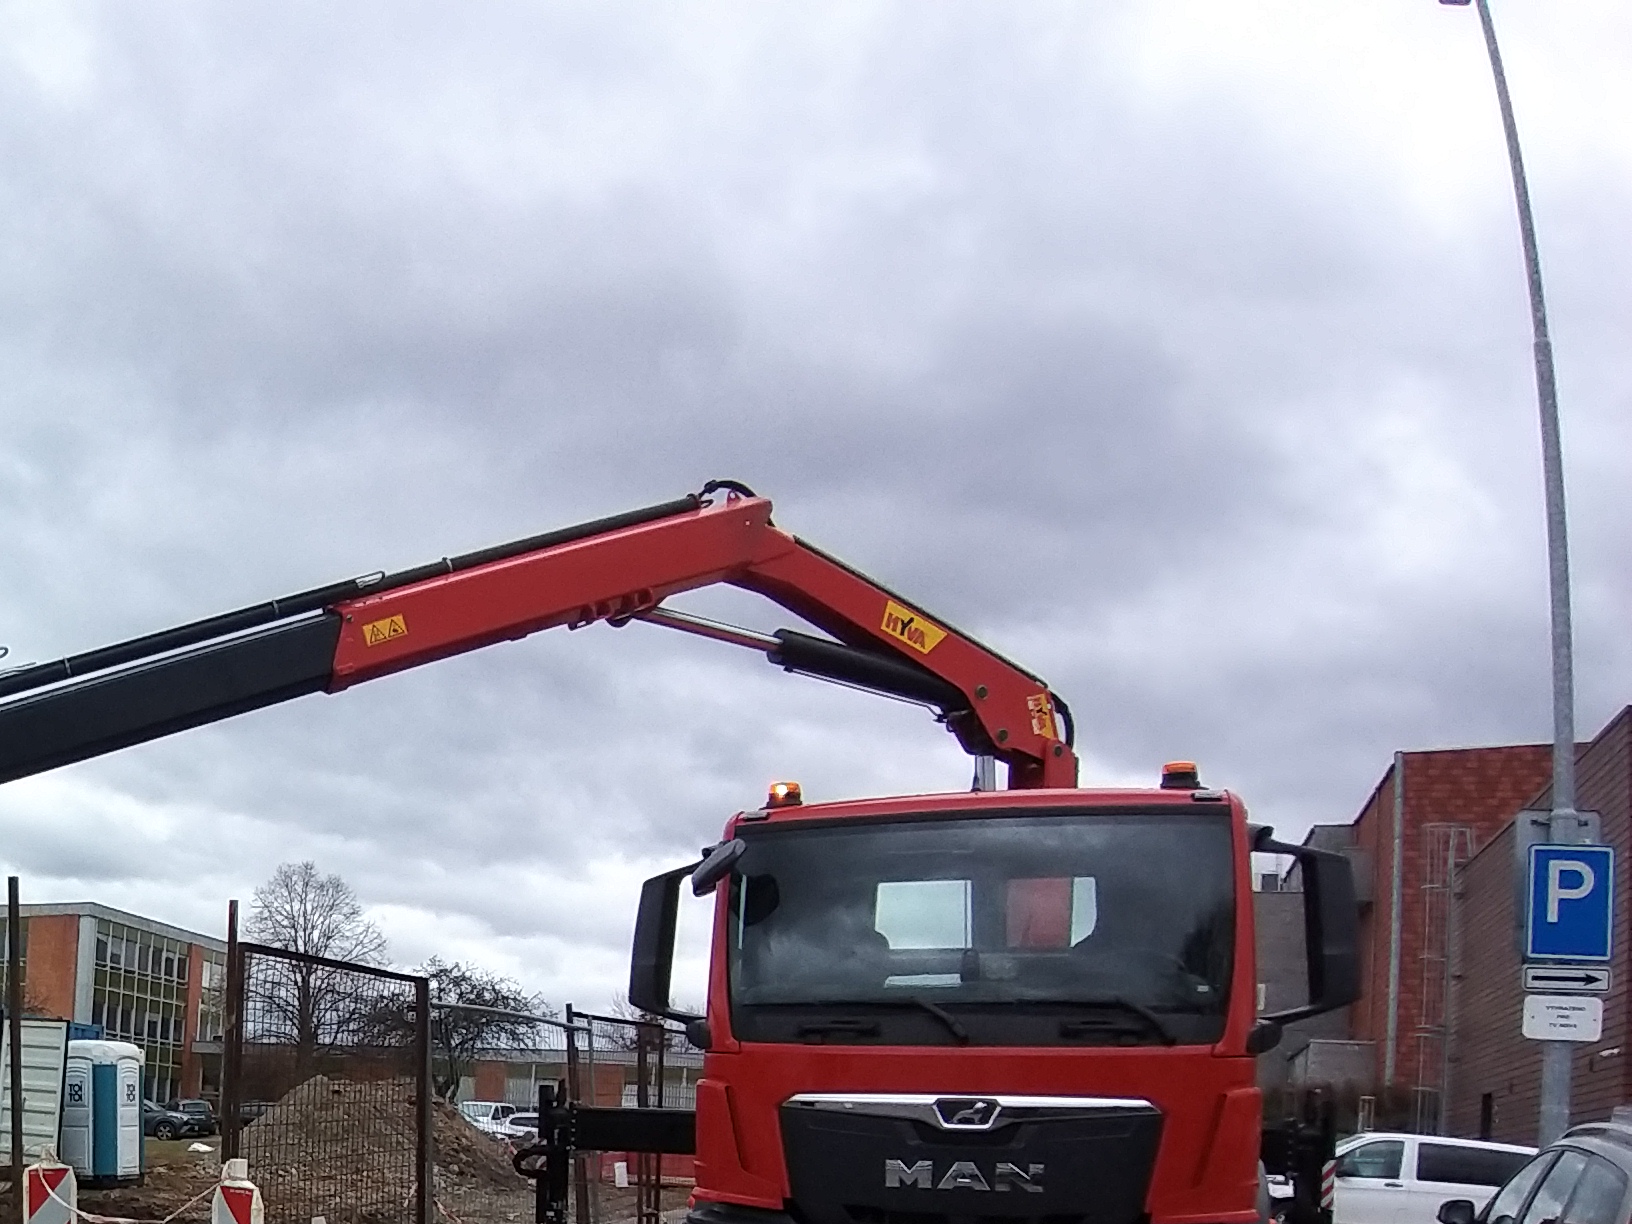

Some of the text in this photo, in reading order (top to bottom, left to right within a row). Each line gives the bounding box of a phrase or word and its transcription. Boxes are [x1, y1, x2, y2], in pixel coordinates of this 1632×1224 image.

[885, 612, 927, 650] HYVA
[1547, 860, 1594, 923] P
[885, 1159, 1045, 1193] MAN
